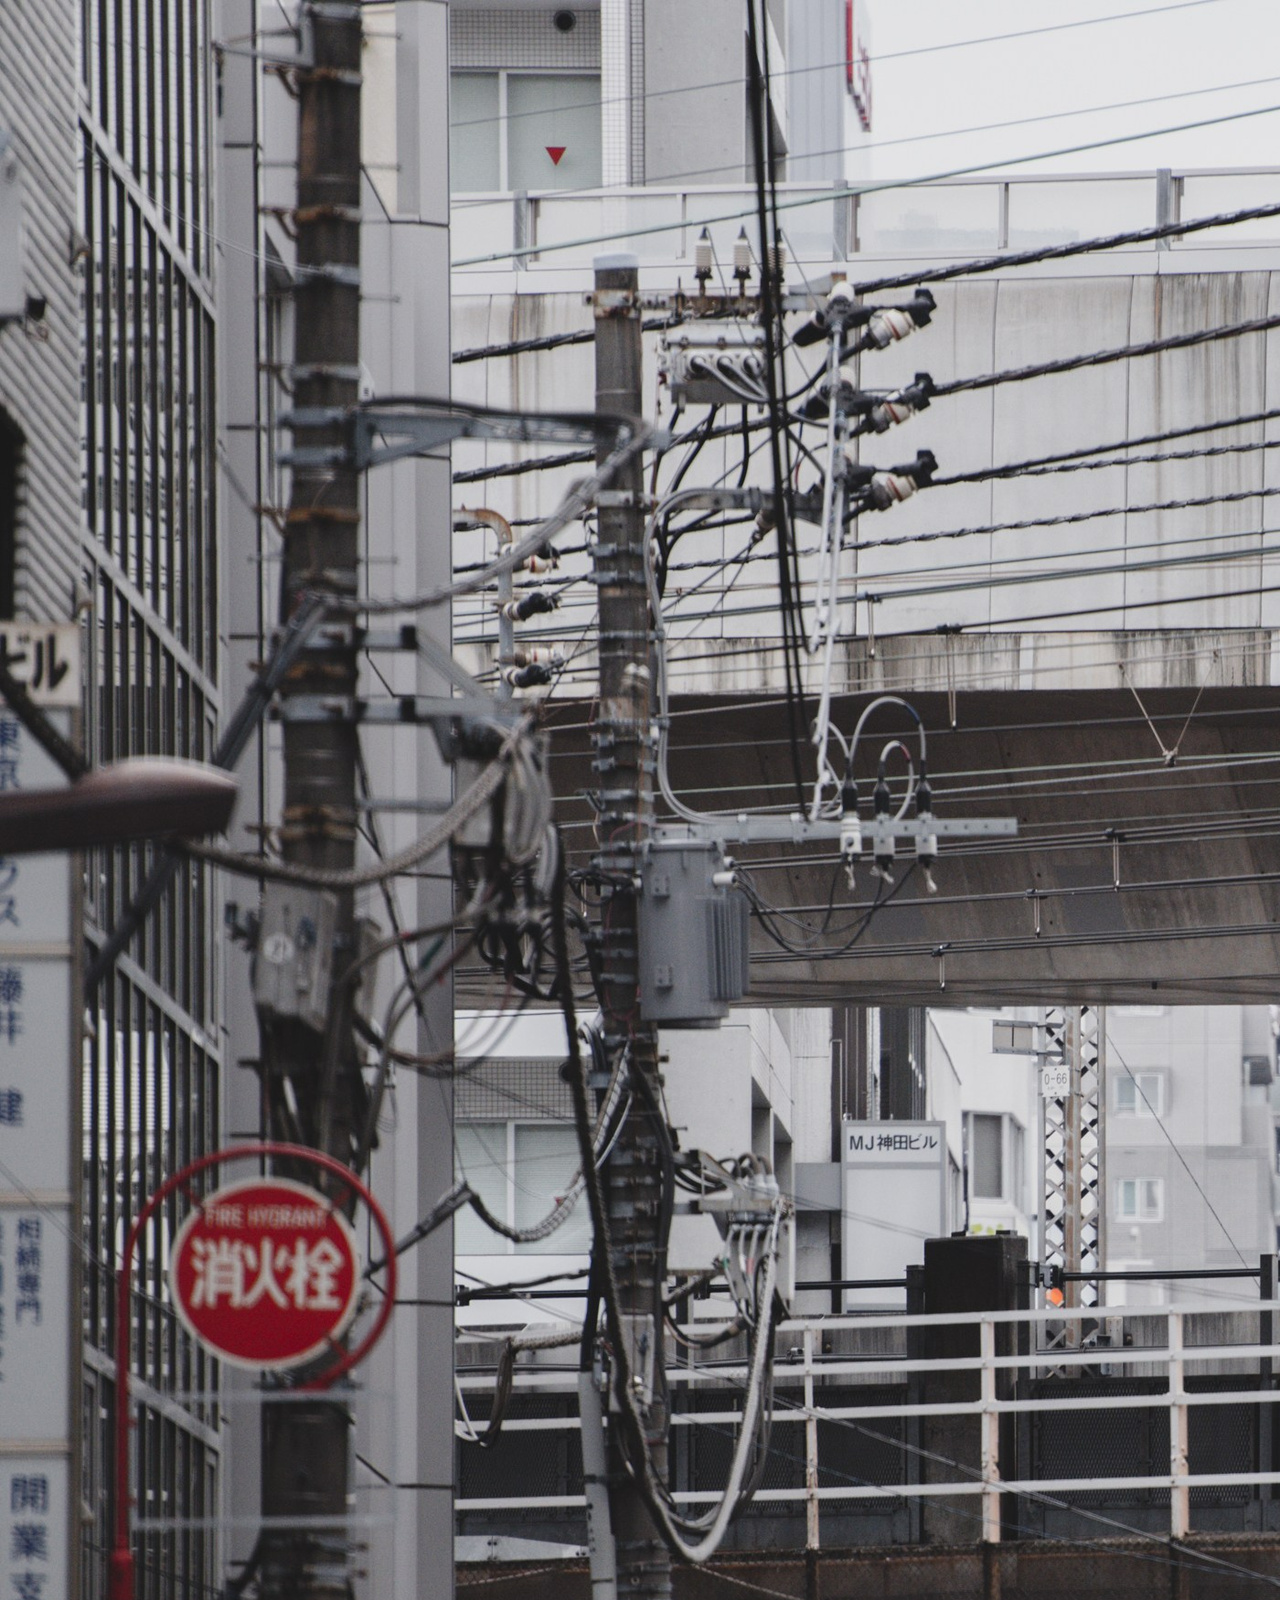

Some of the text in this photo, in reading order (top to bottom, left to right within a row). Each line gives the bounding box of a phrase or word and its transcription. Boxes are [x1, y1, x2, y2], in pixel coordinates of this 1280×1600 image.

[205, 1206, 327, 1228] FIRE HYDRANT
[190, 1236, 343, 1313] 消火栓
